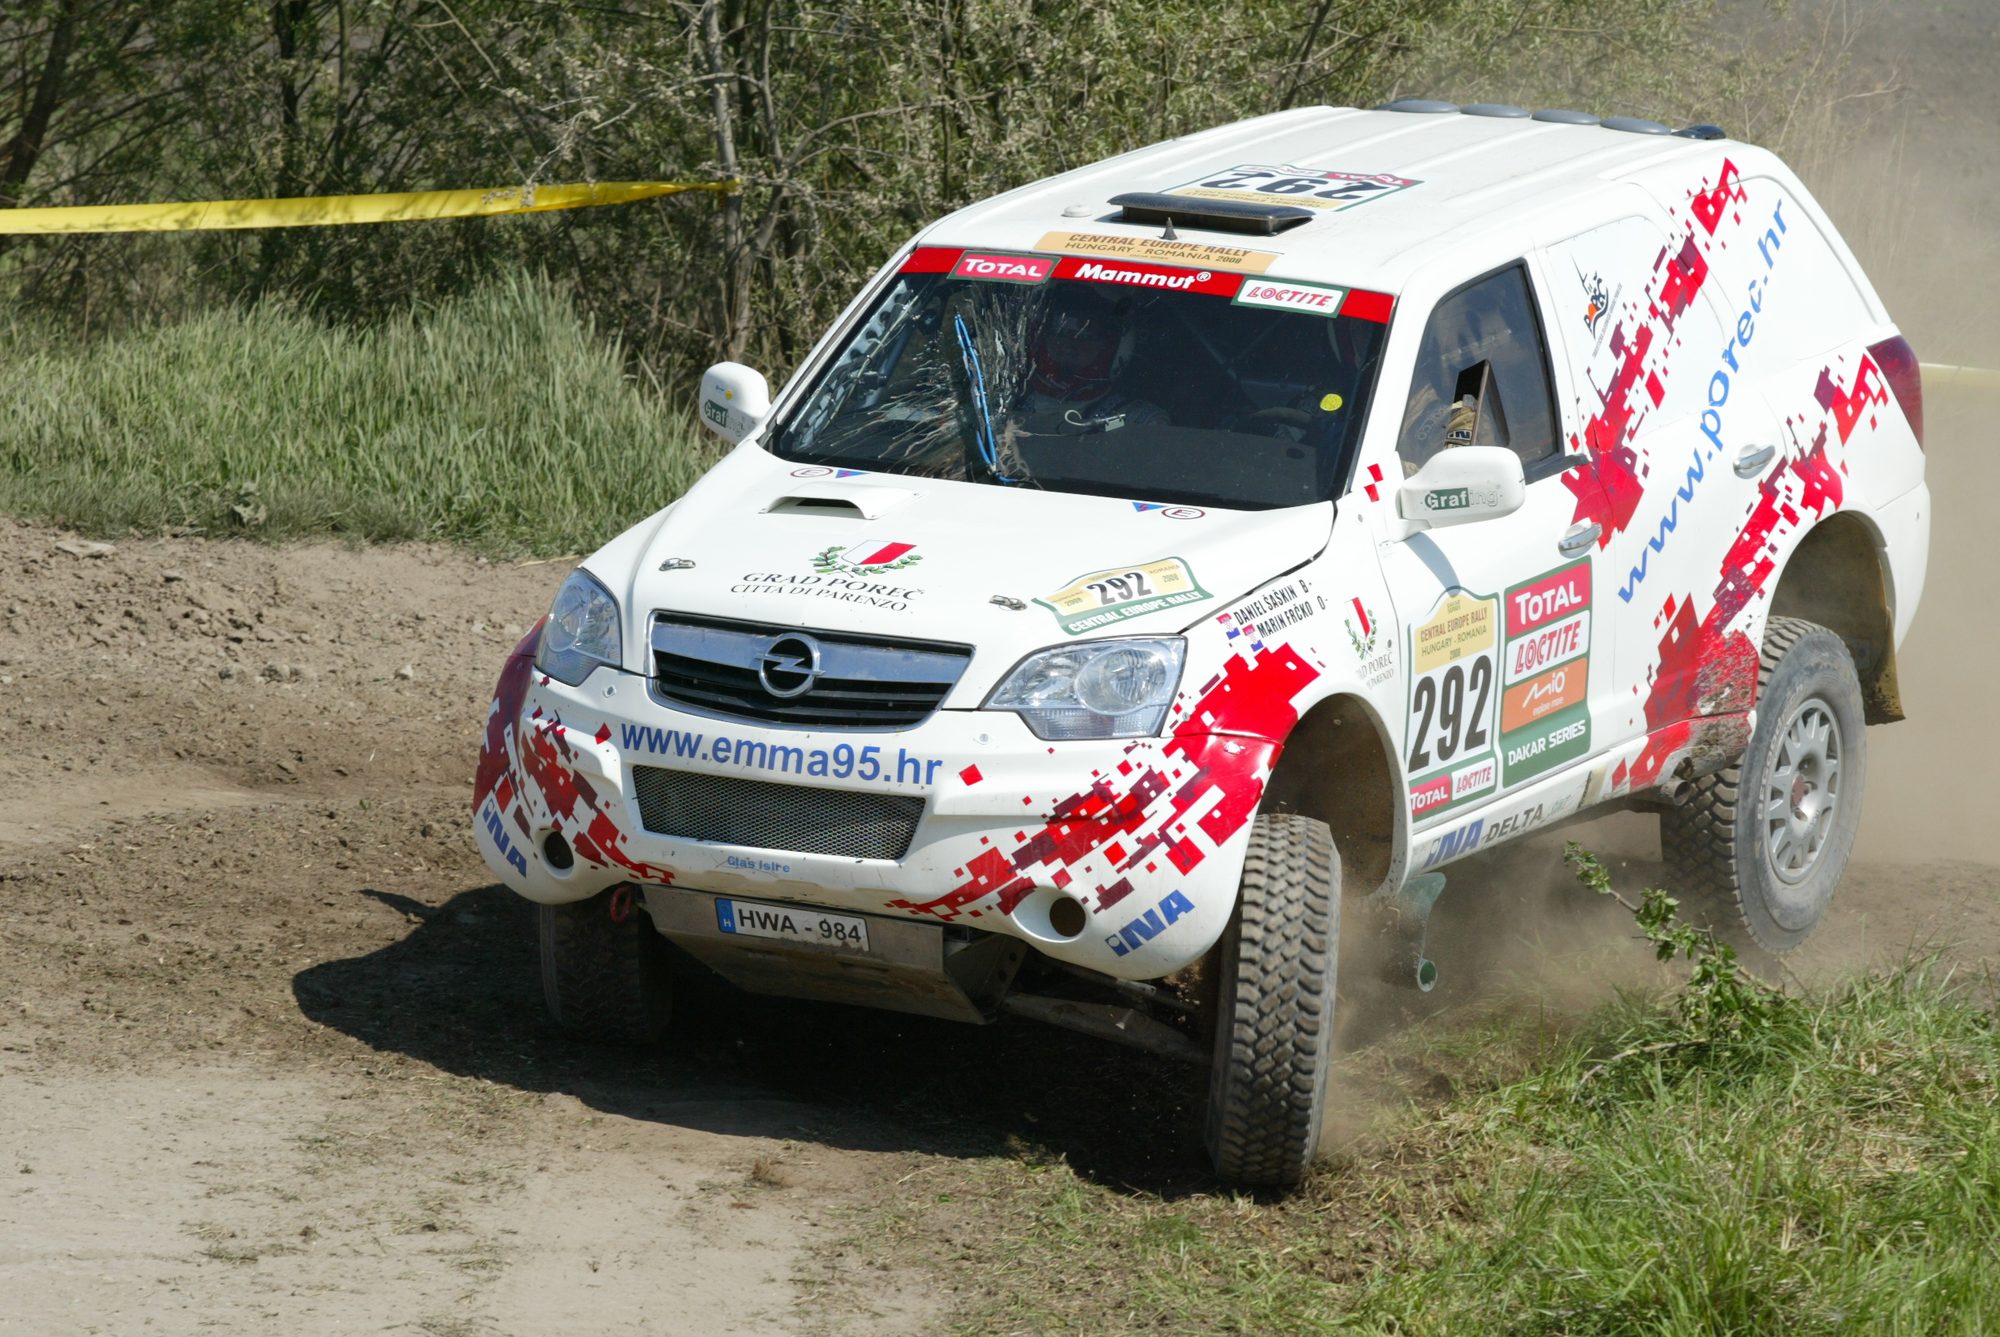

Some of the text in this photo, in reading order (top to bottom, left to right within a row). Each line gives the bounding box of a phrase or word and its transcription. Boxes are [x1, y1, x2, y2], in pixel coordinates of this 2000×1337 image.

[1200, 172, 1390, 199] 292
[1064, 242, 1132, 253] HUNGARY
[1145, 248, 1210, 261] ROMANIA
[1215, 255, 1243, 264] 2008
[1069, 233, 1252, 257] CENTRAL EUROPE RALLY
[965, 258, 1043, 277] TOTAL
[1247, 286, 1333, 307] LOCTITE
[1617, 199, 1787, 604] www.porec.hr
[743, 572, 926, 600] GRAD POREČ
[789, 586, 813, 595] DI
[816, 589, 907, 611] PARENZO
[1086, 572, 1152, 605] 292
[1067, 591, 1204, 632] CENTRAL EUROPE RALLY
[1233, 600, 1267, 626] DANIEL
[1515, 581, 1582, 625] TOTAL
[1256, 613, 1288, 638] MARIN
[1421, 607, 1487, 642] CENTRAL EUROPE RALLY
[1421, 637, 1452, 656] HUNGARY
[1457, 624, 1487, 643] ROMANIA
[1514, 620, 1582, 675] LOCTITE
[1408, 655, 1492, 773] 292
[621, 723, 943, 785] www.emma95.hr
[1508, 720, 1586, 766] DAKAR SERIES
[1411, 766, 1492, 811] TOTAL LOCTITE
[1485, 803, 1543, 843] DELTA
[727, 855, 755, 869] Glas
[723, 919, 731, 928] H
